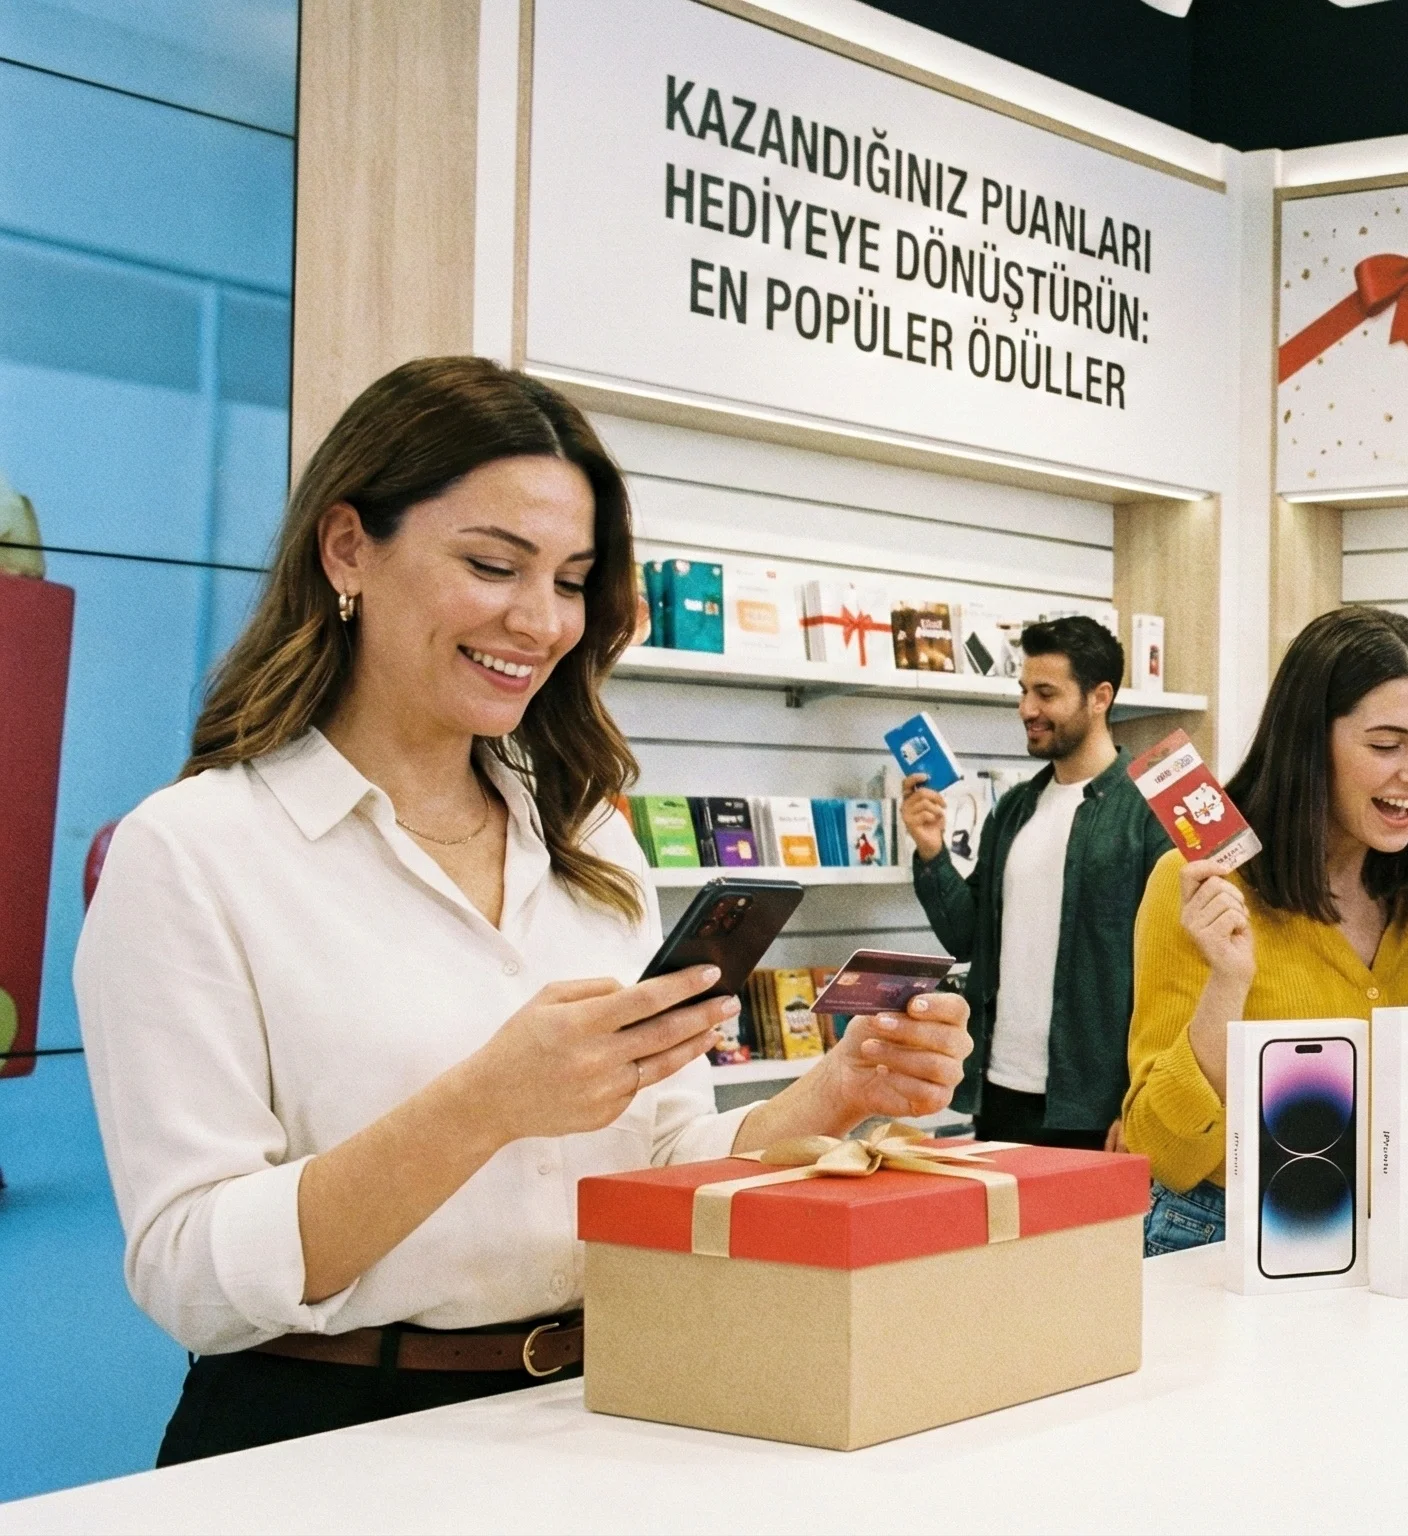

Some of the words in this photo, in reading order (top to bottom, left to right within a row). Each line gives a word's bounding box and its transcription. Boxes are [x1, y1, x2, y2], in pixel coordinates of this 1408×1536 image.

[665, 163, 880, 273] HEDİYEYE
[896, 226, 1149, 344] DÖNÜŞTÜRÜN:
[666, 75, 969, 219] KAZANDIĞINIZ
[982, 178, 1151, 274] PUANLARI
[690, 259, 748, 325] EN
[766, 277, 953, 371] POPÜLER
[968, 315, 1126, 410] ÖDÜLLER
